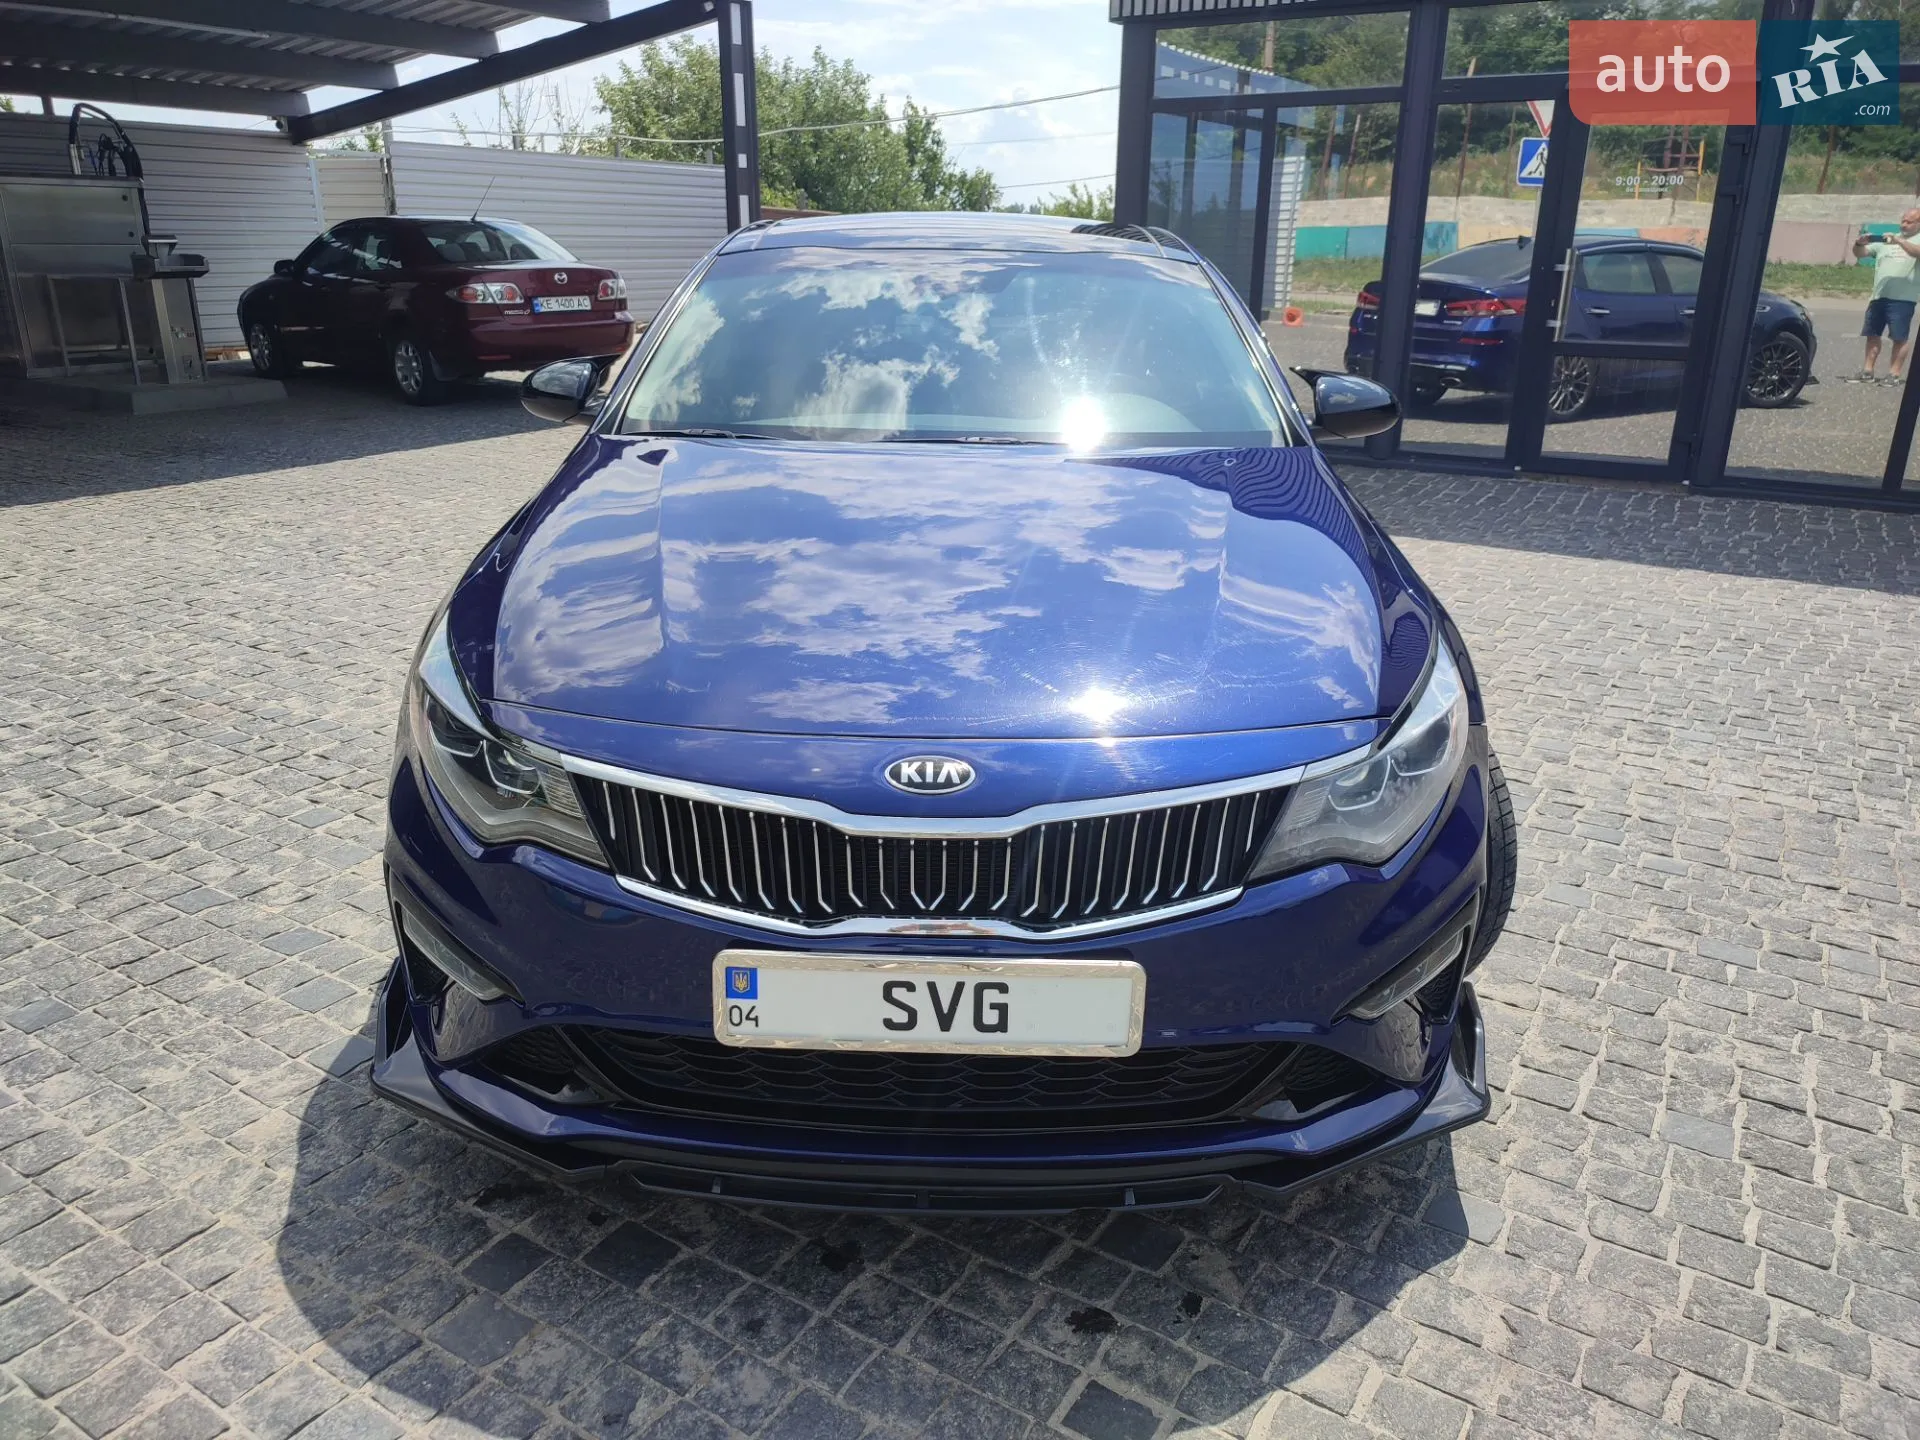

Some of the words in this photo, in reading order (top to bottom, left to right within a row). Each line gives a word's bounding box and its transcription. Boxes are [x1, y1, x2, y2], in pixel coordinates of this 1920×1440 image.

[1615, 176, 1640, 186] 9:00
[1651, 175, 1684, 186] 20:00
[541, 299, 553, 310] KE
[556, 298, 574, 308] 1400
[577, 297, 588, 307] AC
[900, 761, 961, 783] KIA
[728, 1004, 759, 1028] 04
[882, 980, 1010, 1033] SVG
